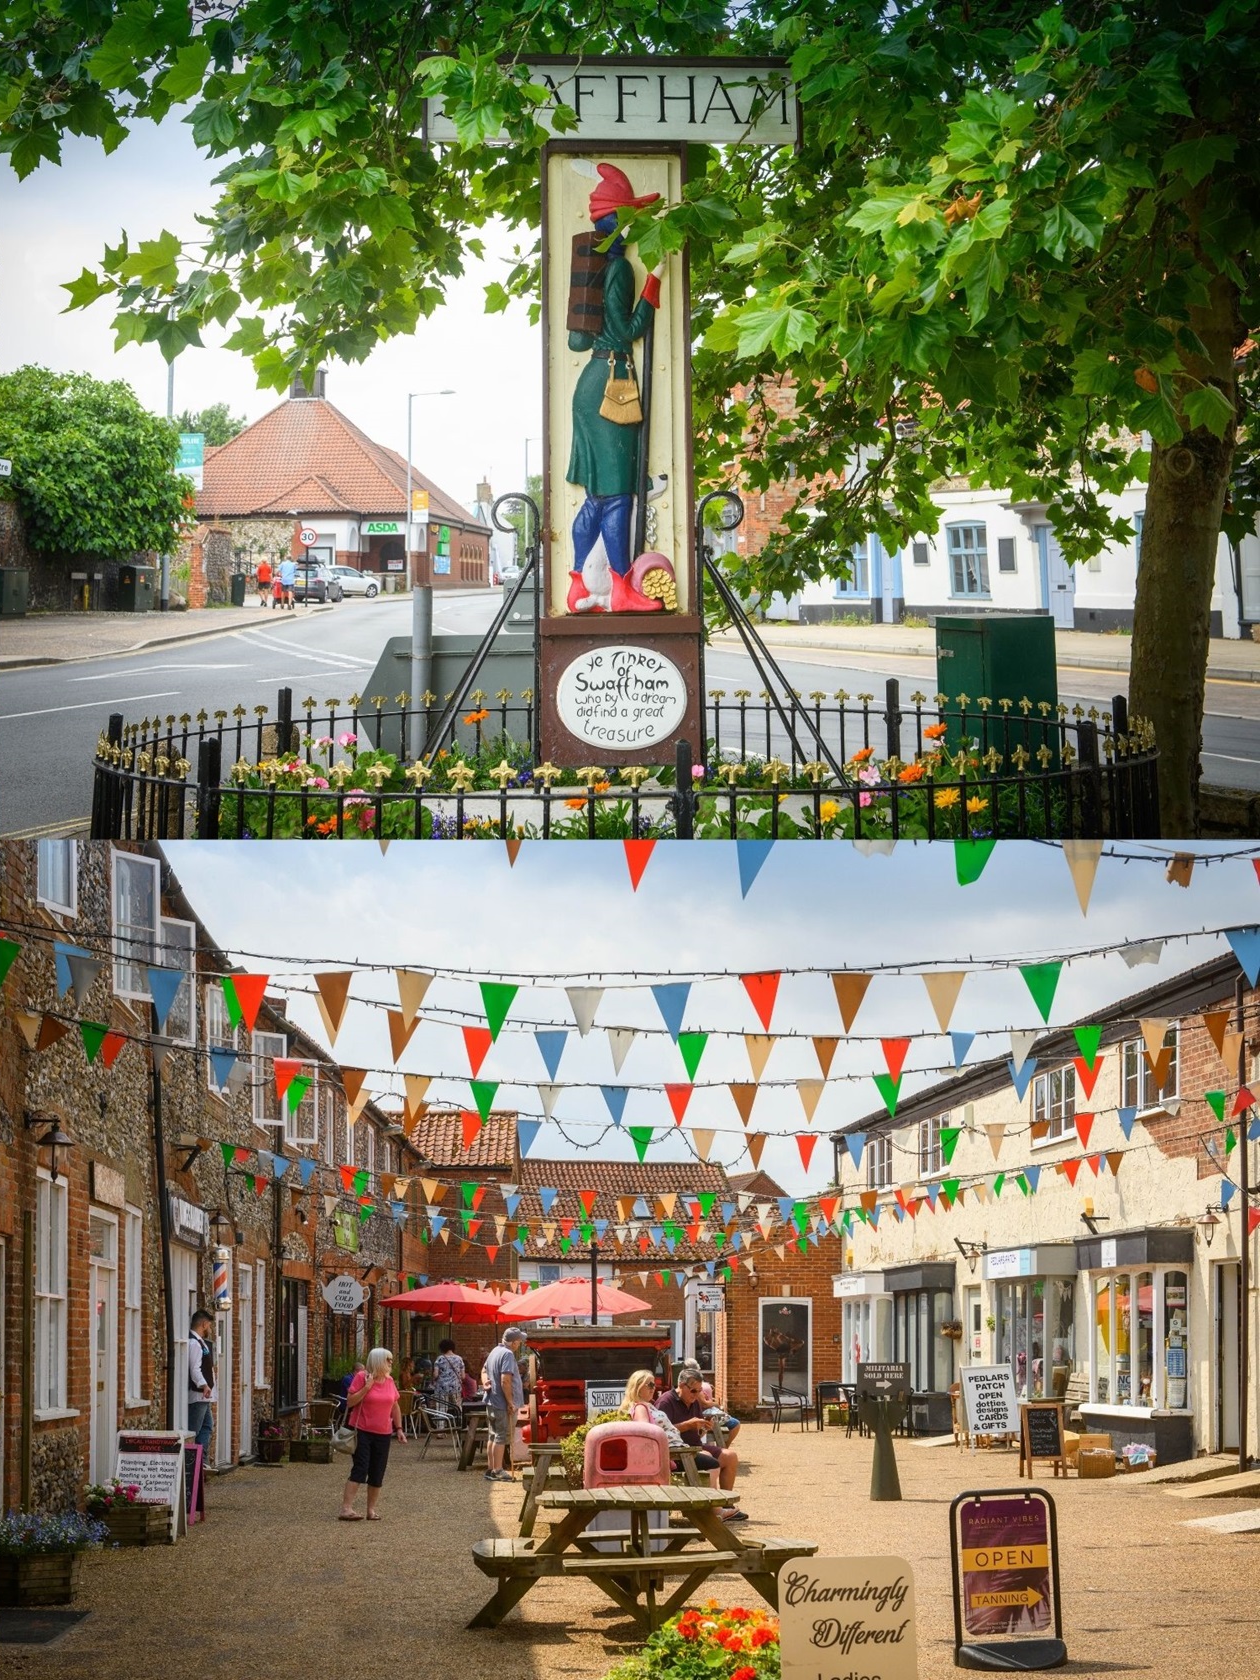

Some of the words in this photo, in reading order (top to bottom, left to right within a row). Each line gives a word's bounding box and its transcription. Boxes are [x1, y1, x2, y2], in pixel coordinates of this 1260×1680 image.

[434, 74, 791, 125] AFFHAM
[367, 522, 398, 533] ASDA
[301, 532, 314, 541] 30
[617, 665, 633, 679] of
[575, 672, 670, 701] Swaffham
[575, 693, 601, 705] who
[605, 692, 619, 708] by
[631, 692, 640, 701] a
[641, 692, 676, 705] dream
[620, 710, 628, 718] a
[633, 705, 665, 722] great
[584, 719, 655, 742] treasure
[968, 1373, 1010, 1383] PEDLARS
[975, 1382, 1005, 1390] PATCH
[978, 1391, 1003, 1400] OPEN
[975, 1400, 1006, 1408] dotties
[976, 1406, 1009, 1415] designs
[978, 1412, 1009, 1421] CARDS
[973, 1423, 980, 1431] &
[981, 1421, 1007, 1430] GIFTS
[968, 1517, 1009, 1525] RADIANT
[975, 1550, 1033, 1567] OPEN
[783, 1571, 909, 1612] Charmingly
[975, 1593, 1029, 1605] TANNING
[809, 1618, 911, 1655] Different
